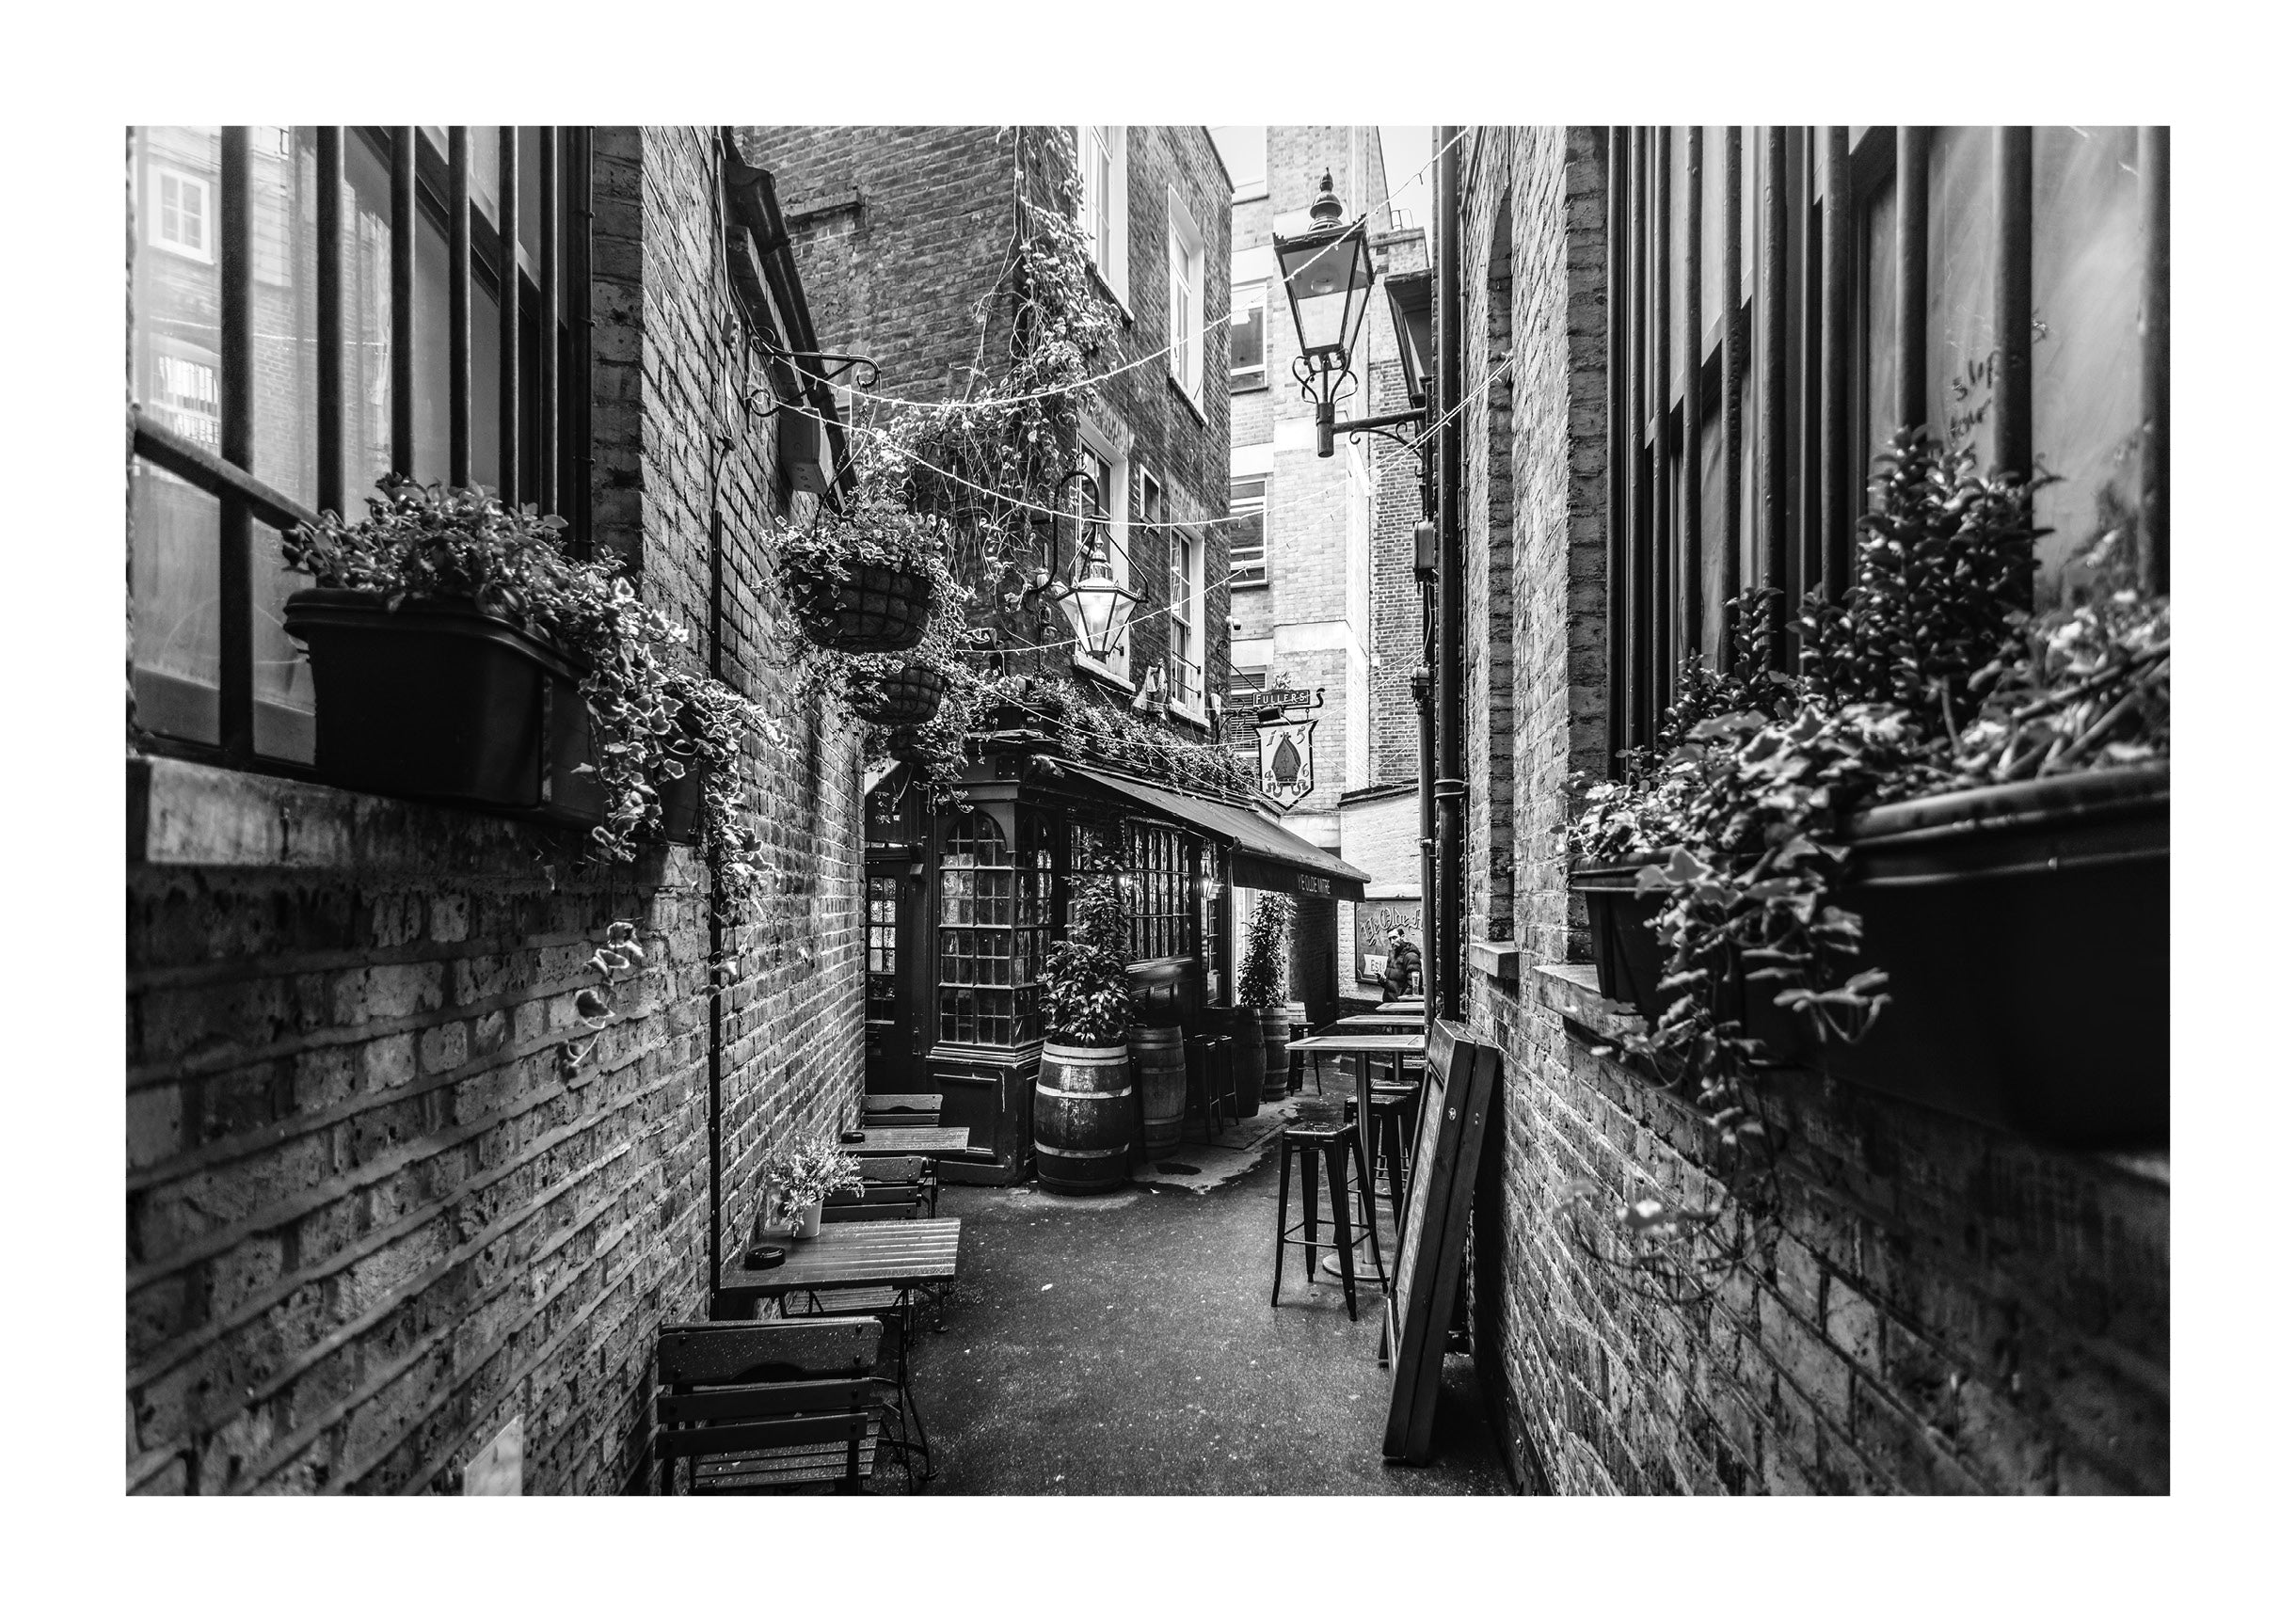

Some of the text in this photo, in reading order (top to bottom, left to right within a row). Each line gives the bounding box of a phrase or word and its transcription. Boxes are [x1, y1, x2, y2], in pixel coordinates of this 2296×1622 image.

[1267, 725, 1306, 746] 1 5
[1264, 763, 1310, 781] 4 6
